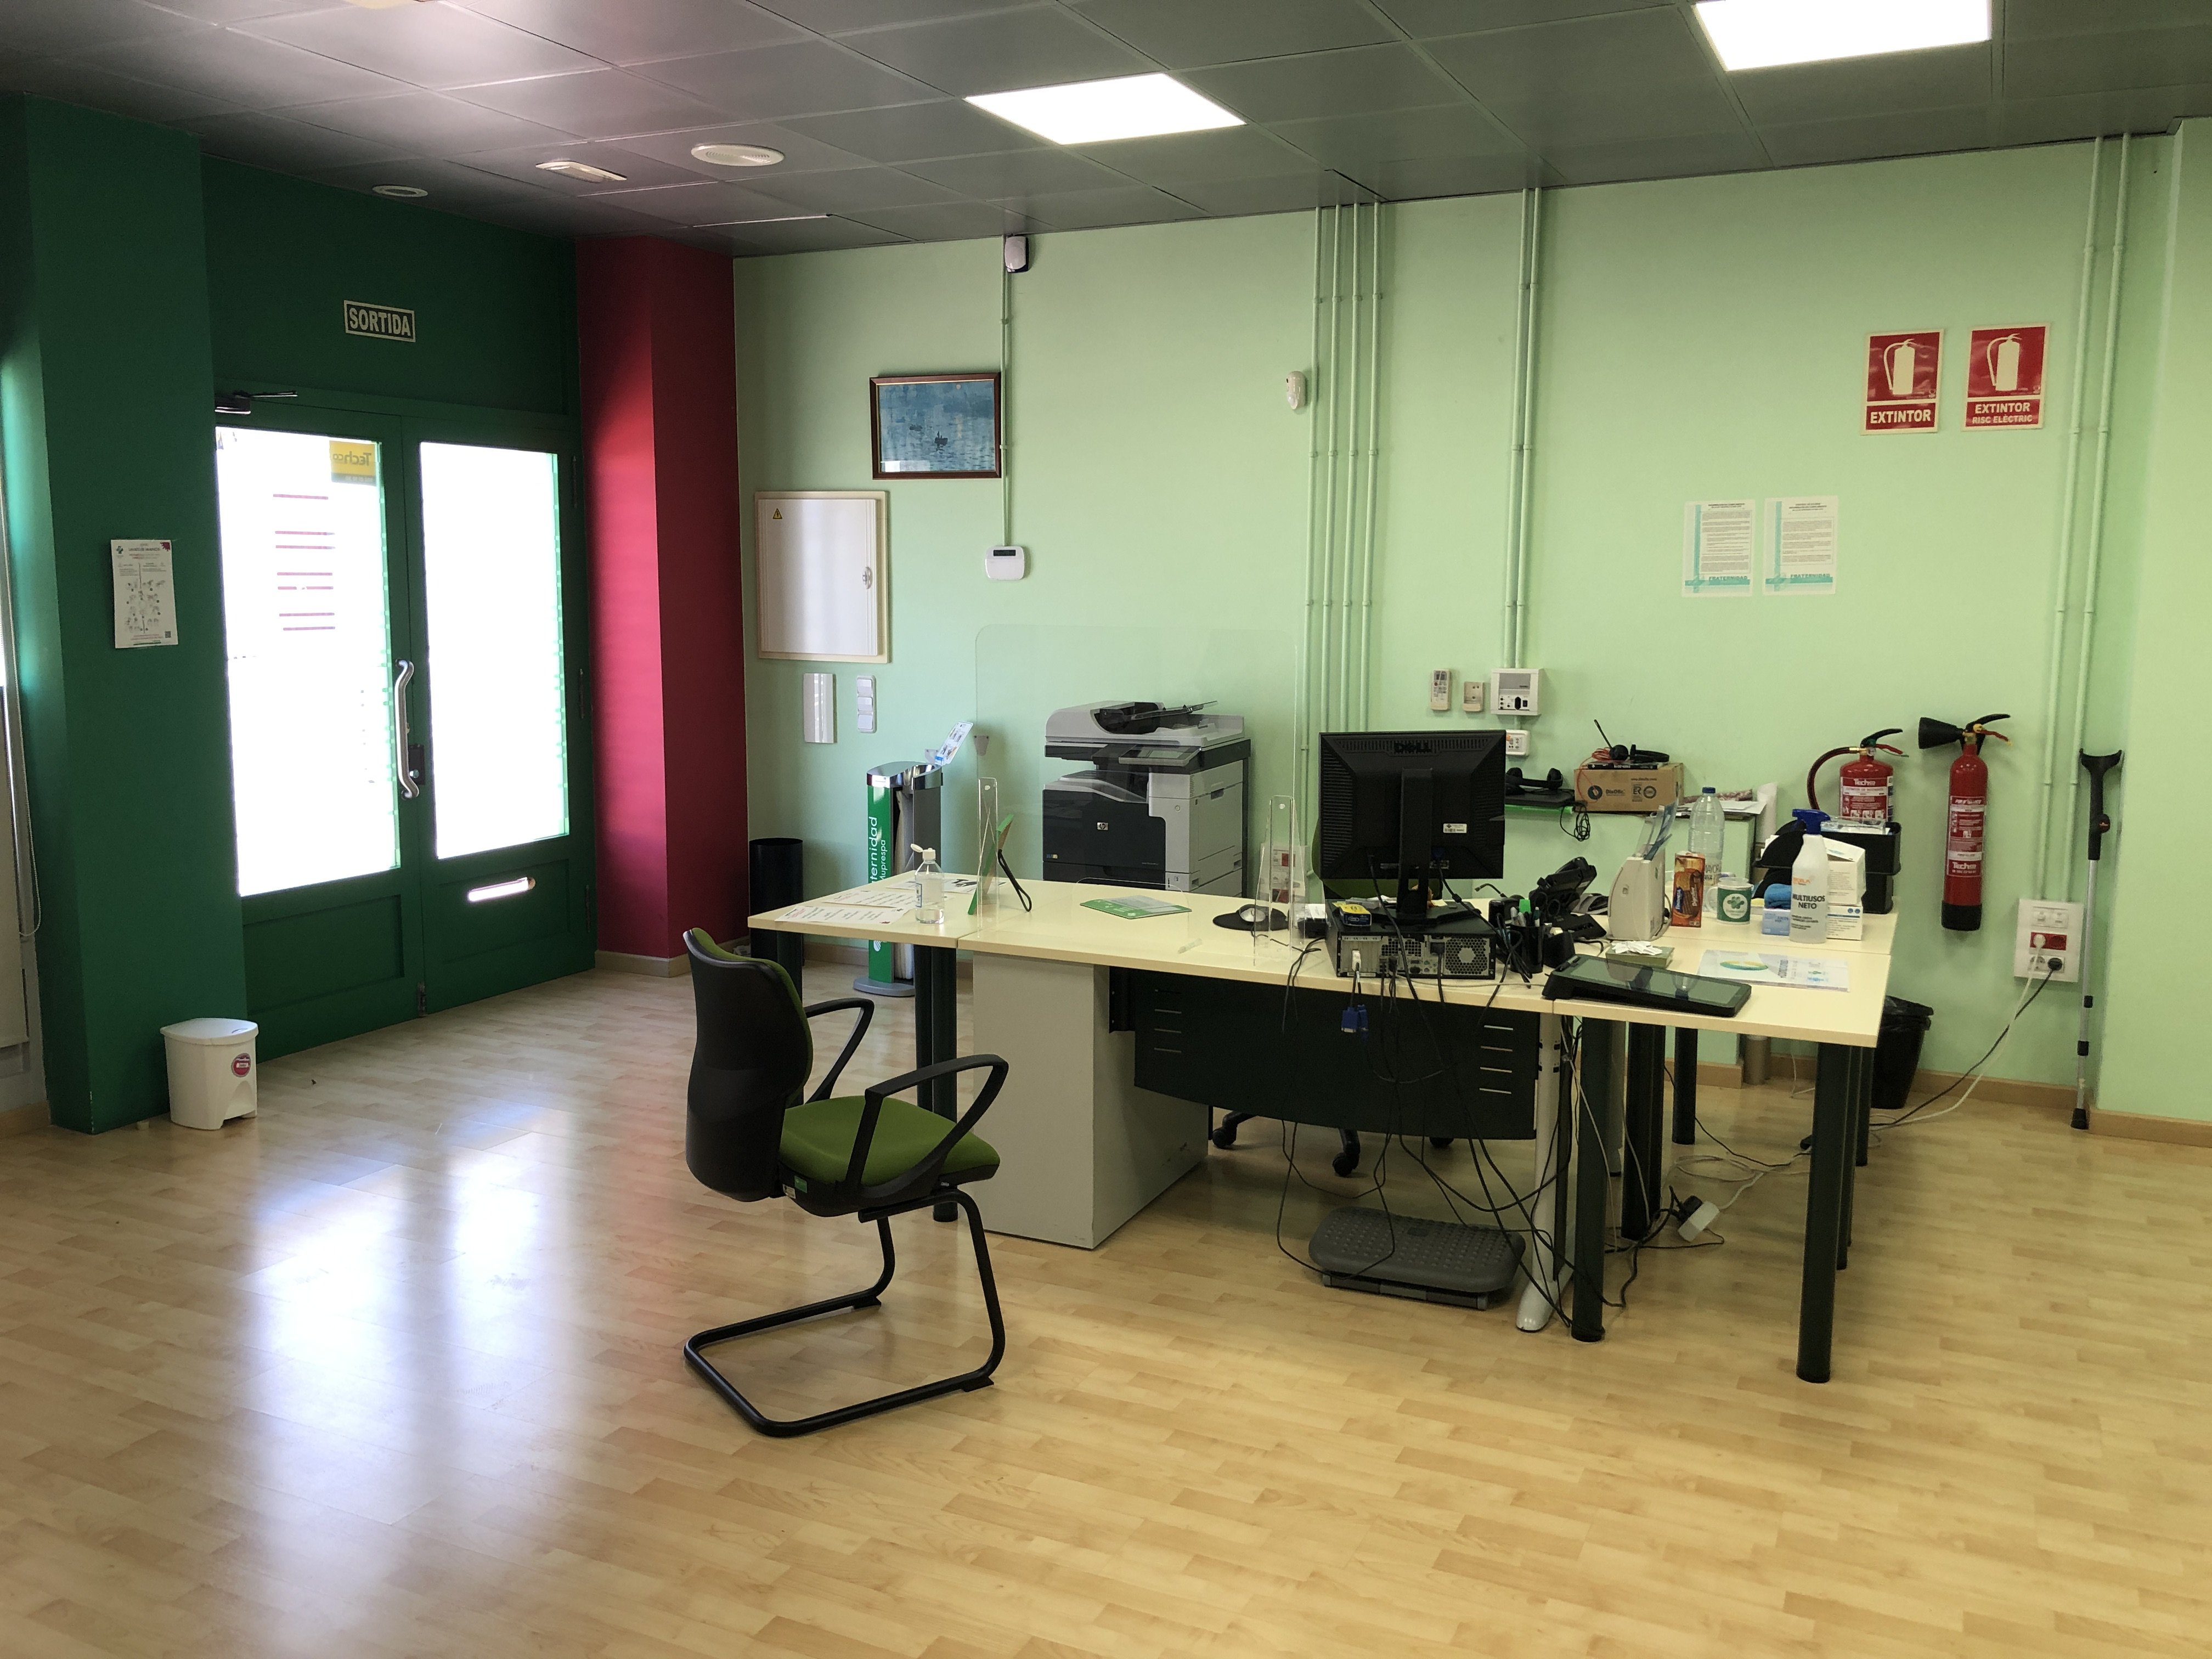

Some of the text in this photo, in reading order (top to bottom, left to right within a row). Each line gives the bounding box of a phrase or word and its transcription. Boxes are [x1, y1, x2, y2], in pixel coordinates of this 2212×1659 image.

[349, 307, 411, 336] SORTIDA
[1975, 402, 2030, 414] EXTINTOR
[1870, 409, 1931, 424] EXTINTOR
[1972, 415, 1991, 424] RISC
[1395, 742, 1432, 753] DELL
[869, 816, 877, 883] ternidad
[1792, 894, 1825, 902] MULTIUSOS
